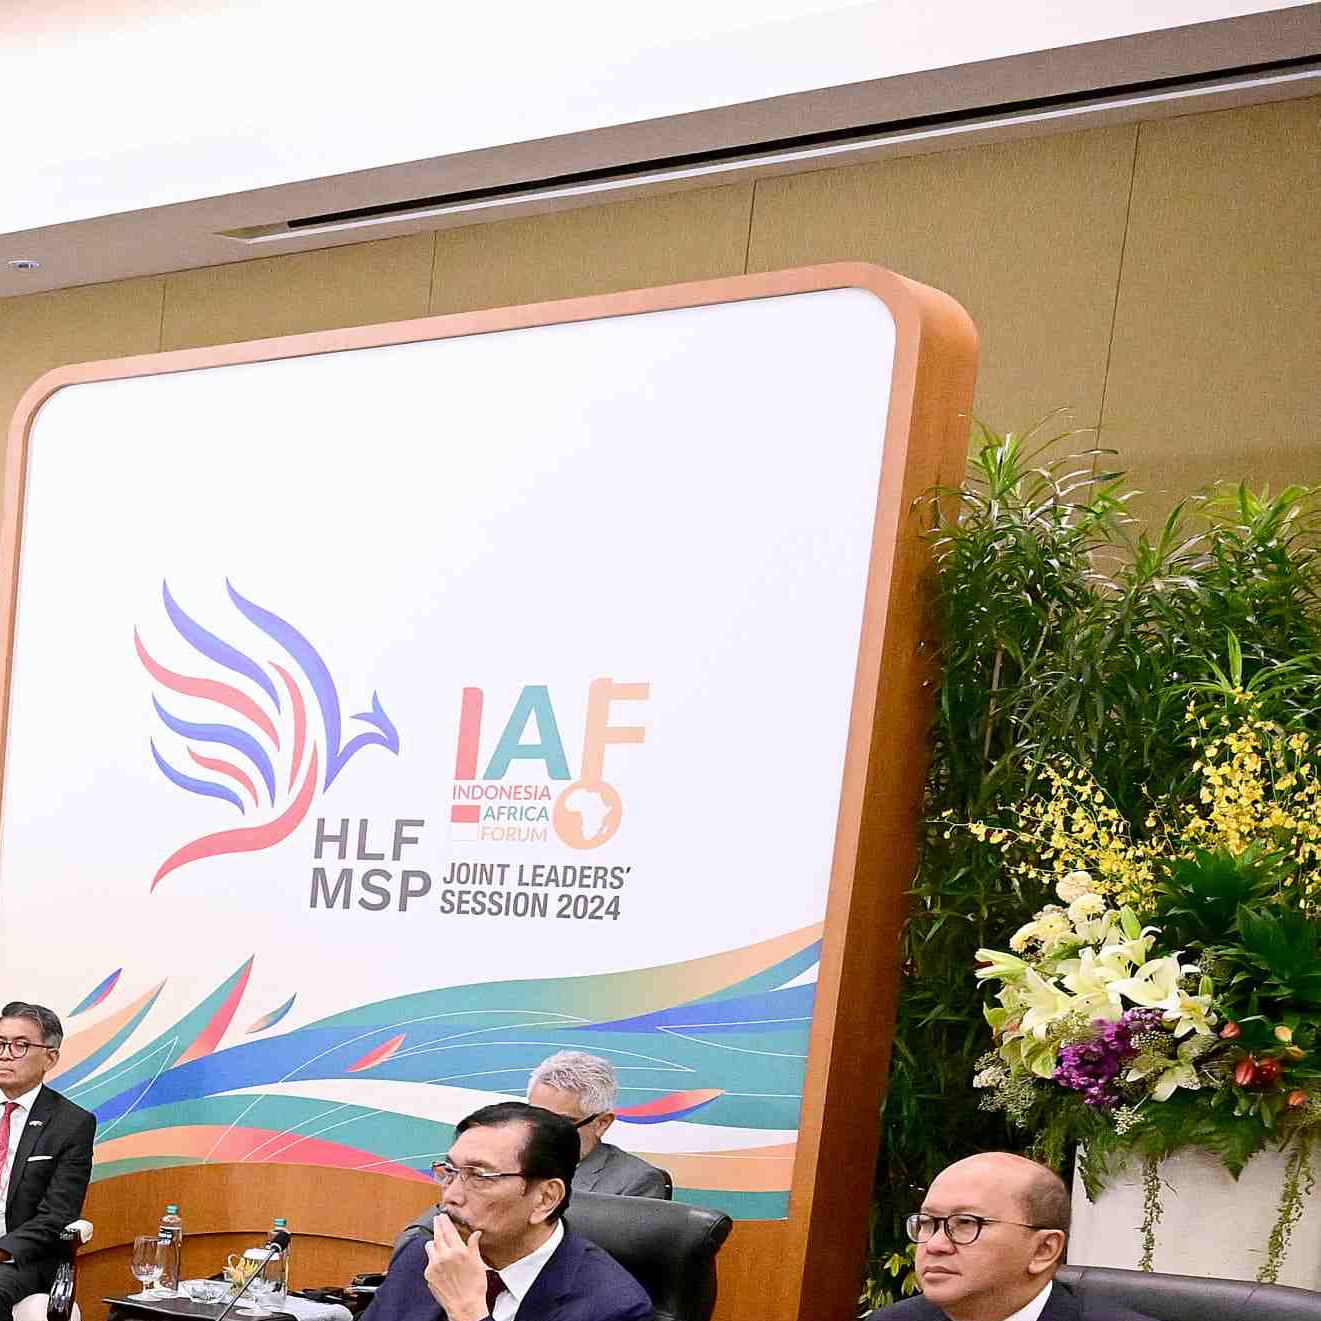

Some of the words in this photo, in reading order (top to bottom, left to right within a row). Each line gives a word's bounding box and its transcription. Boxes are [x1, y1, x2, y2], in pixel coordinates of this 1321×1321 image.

[454, 677, 651, 781] IAF
[452, 784, 552, 801] INDONESIA
[483, 805, 550, 822] AFRICA
[313, 817, 426, 862] HLF
[481, 826, 548, 843] FORUM
[309, 866, 432, 913] MSP
[442, 861, 510, 886] JOINT
[517, 864, 632, 890] LEADERS'
[439, 888, 549, 919] SESSION
[556, 893, 622, 921] 2024
